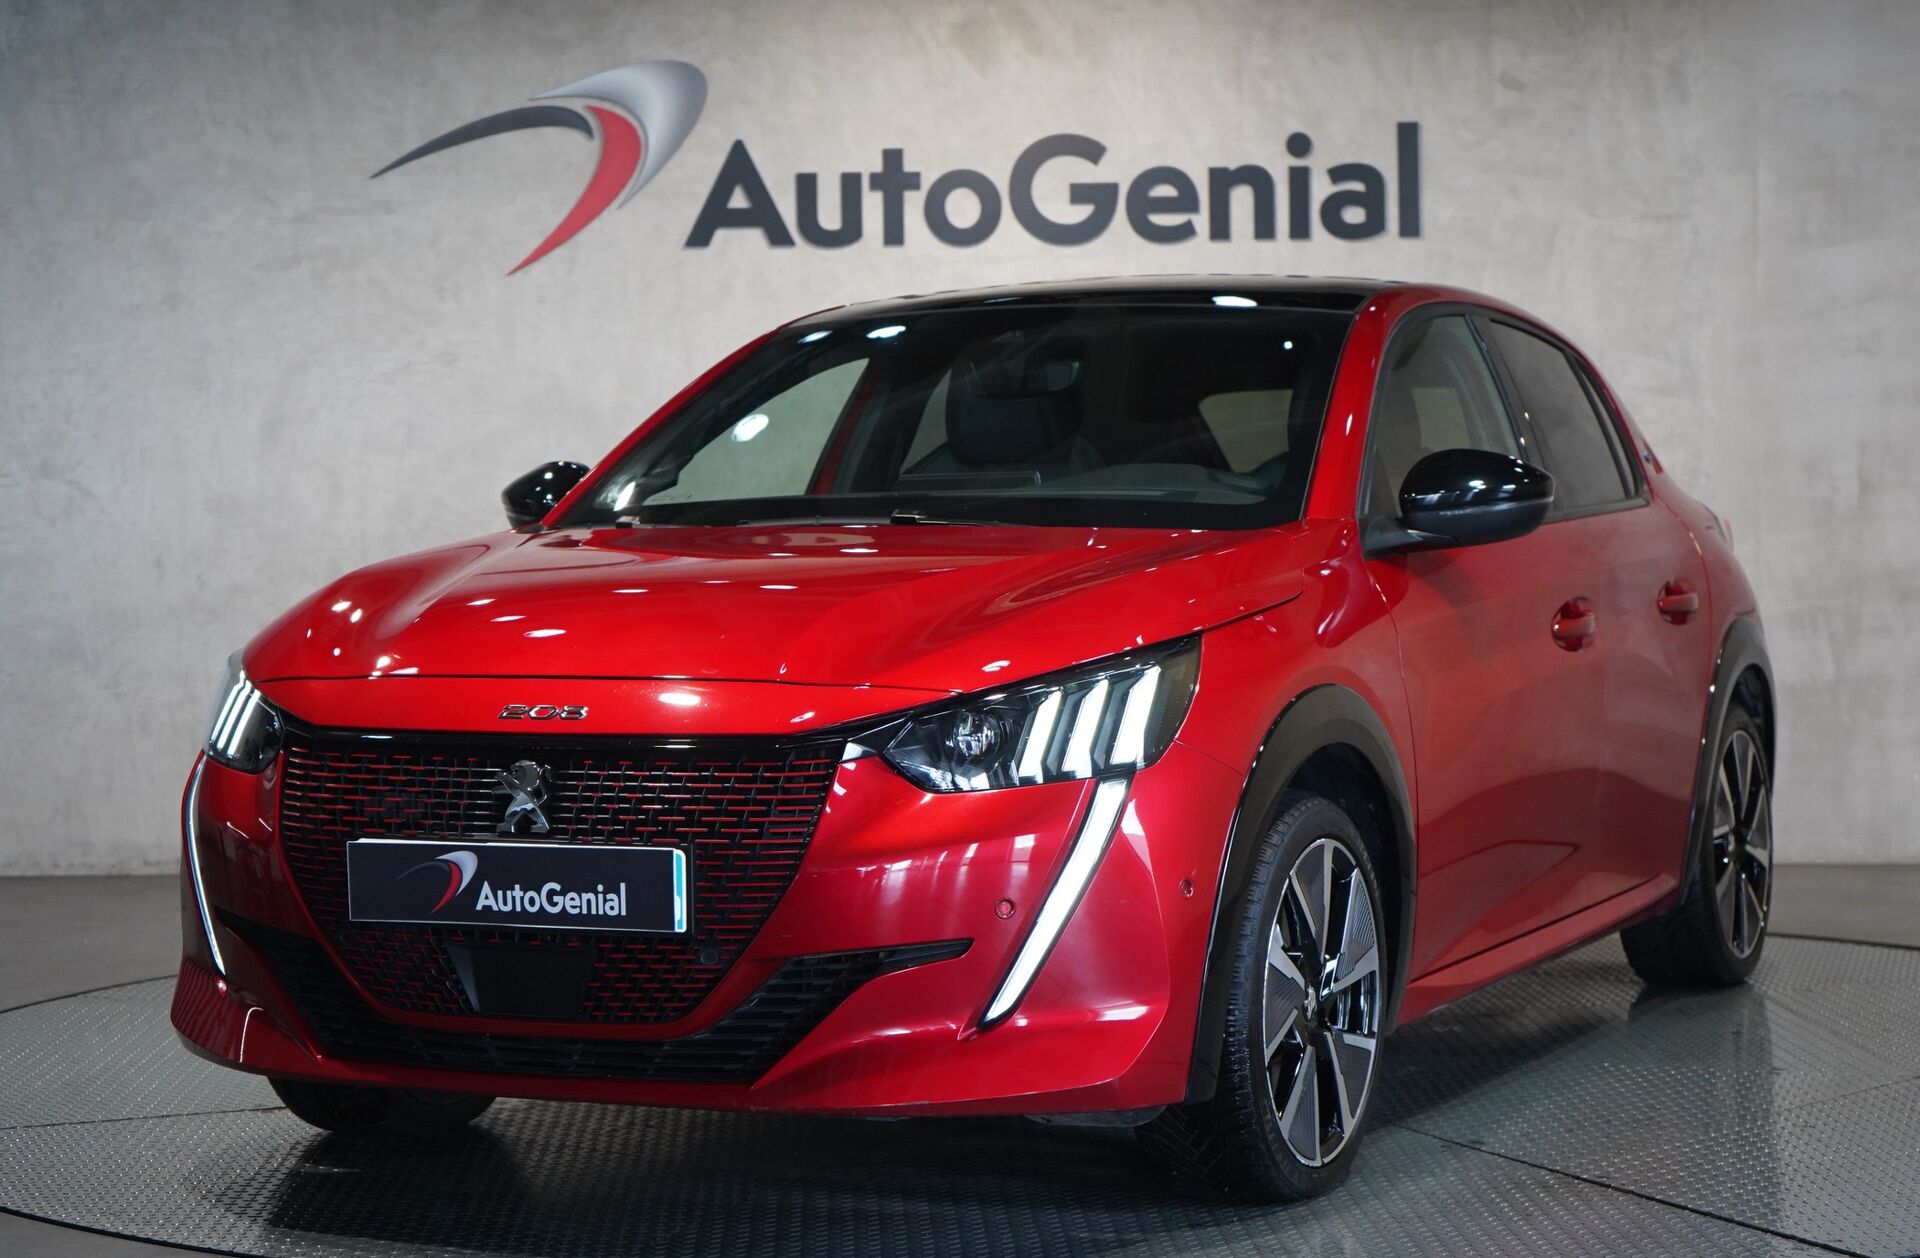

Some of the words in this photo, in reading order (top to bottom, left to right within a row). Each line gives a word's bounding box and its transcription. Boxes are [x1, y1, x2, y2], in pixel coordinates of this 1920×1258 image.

[684, 121, 1421, 249] AutoGenial
[498, 704, 589, 720] 208
[475, 880, 627, 916] AutoGenial
